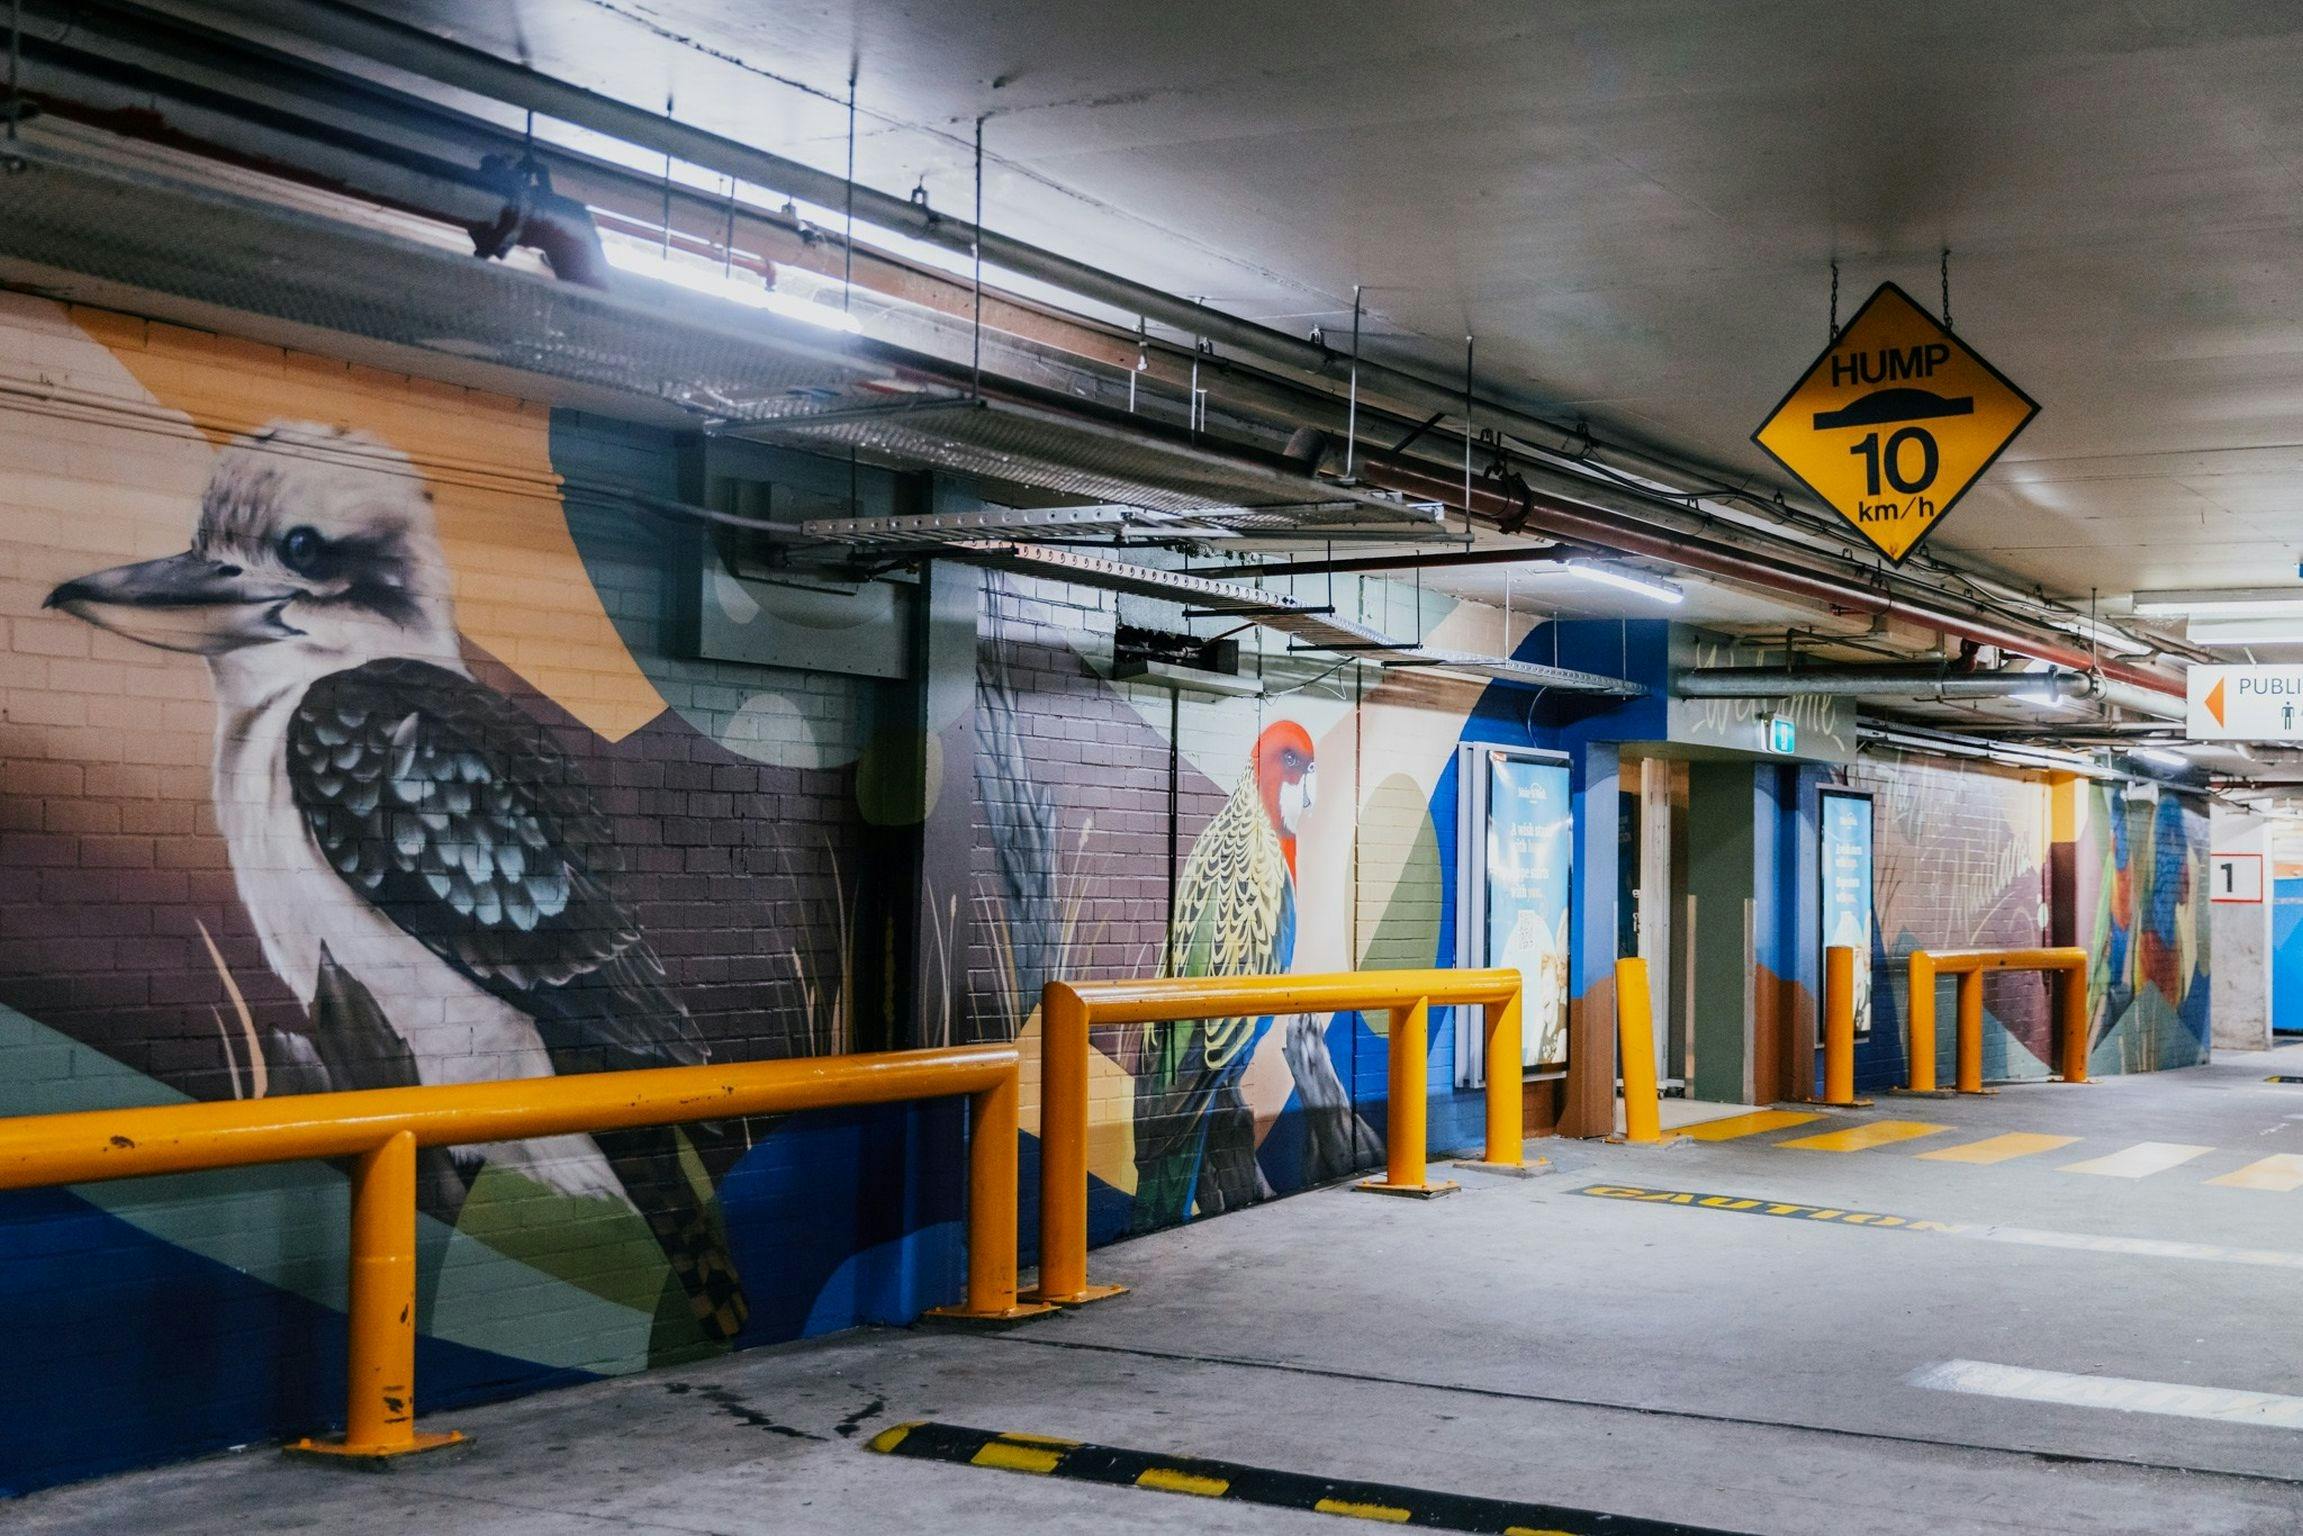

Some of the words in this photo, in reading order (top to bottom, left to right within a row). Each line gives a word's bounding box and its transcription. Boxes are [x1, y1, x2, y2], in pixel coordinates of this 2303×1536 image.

[1831, 343, 1949, 387] HUMP
[1850, 427, 1939, 496] 10
[1858, 497, 1934, 522] km/h
[2221, 863, 2233, 893] 1
[1582, 1187, 1969, 1233] CAUTION
